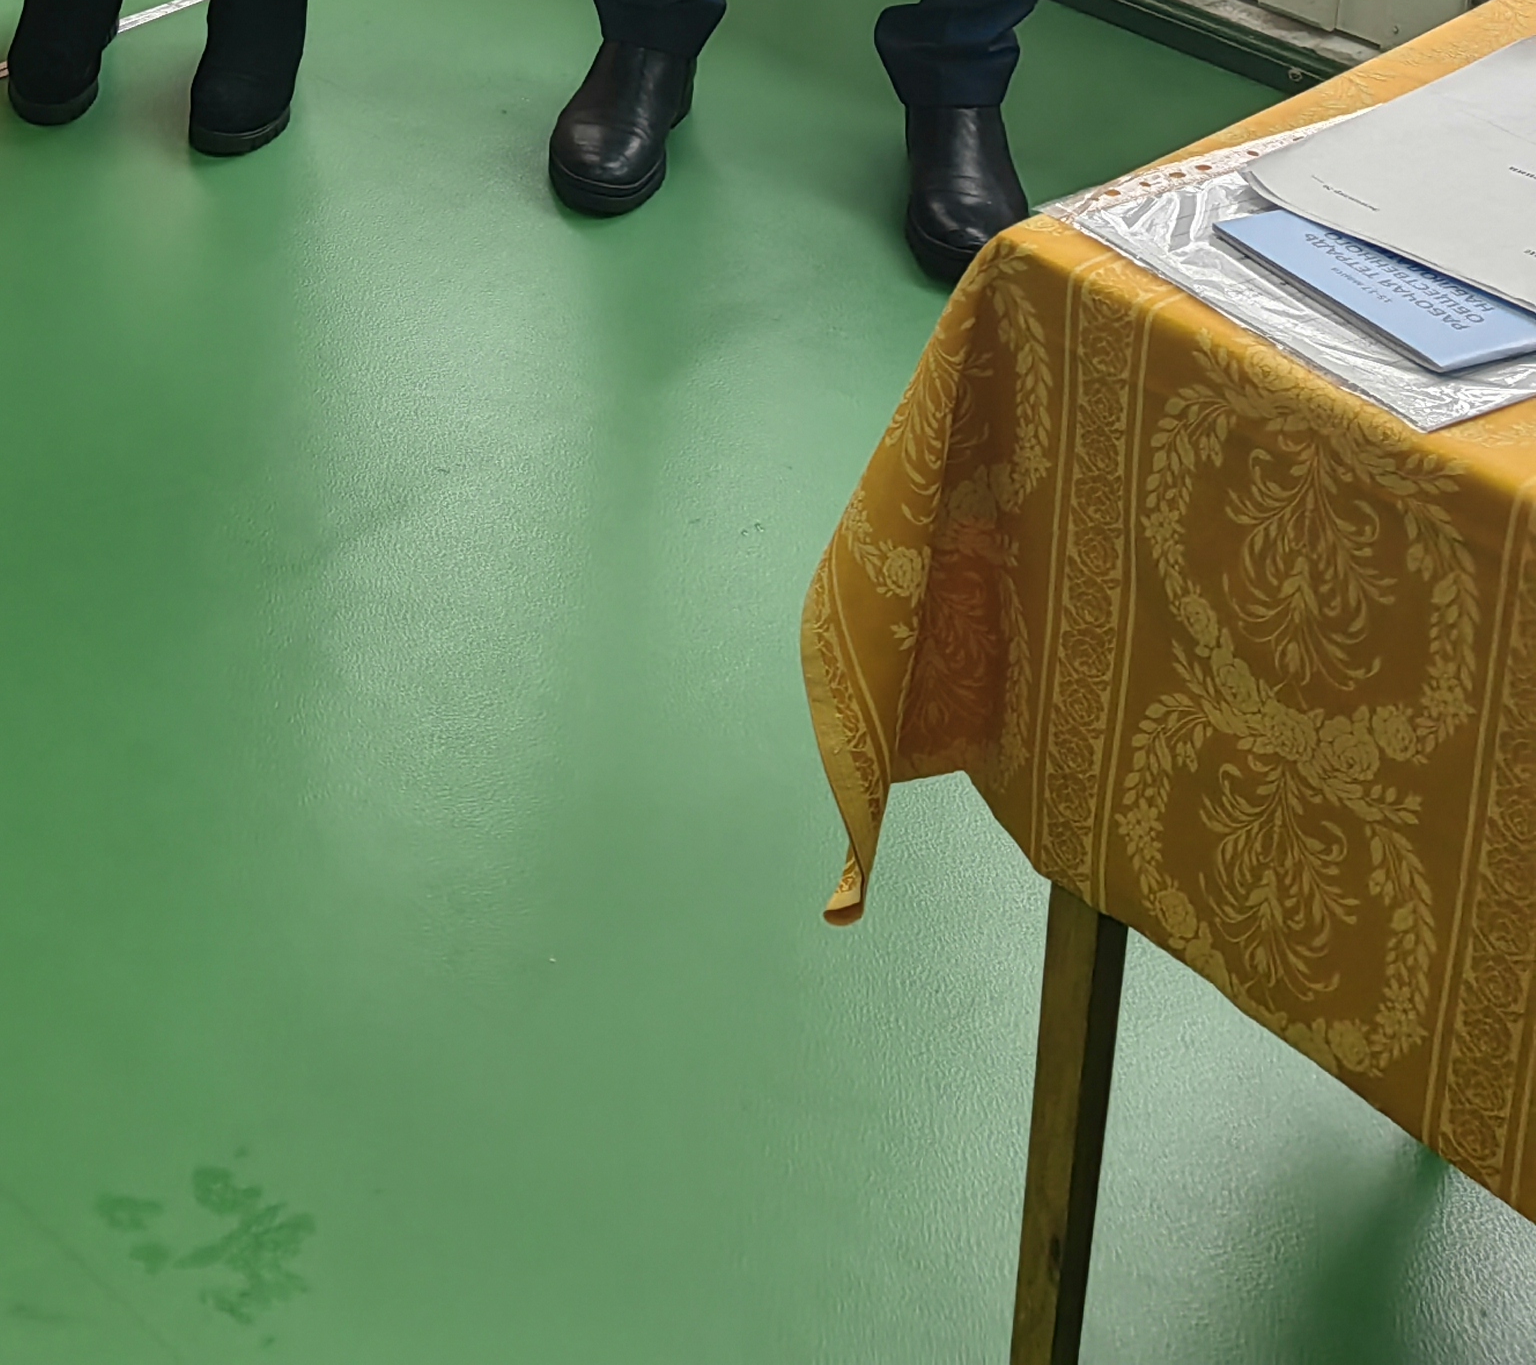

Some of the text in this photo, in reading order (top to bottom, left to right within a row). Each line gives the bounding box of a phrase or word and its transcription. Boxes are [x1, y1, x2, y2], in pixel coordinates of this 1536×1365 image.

[1304, 232, 1471, 331] РАБОЧАЯ ТЕТРАДЬ
[1324, 231, 1485, 324] ОБЩЕСТВЕННОГО
